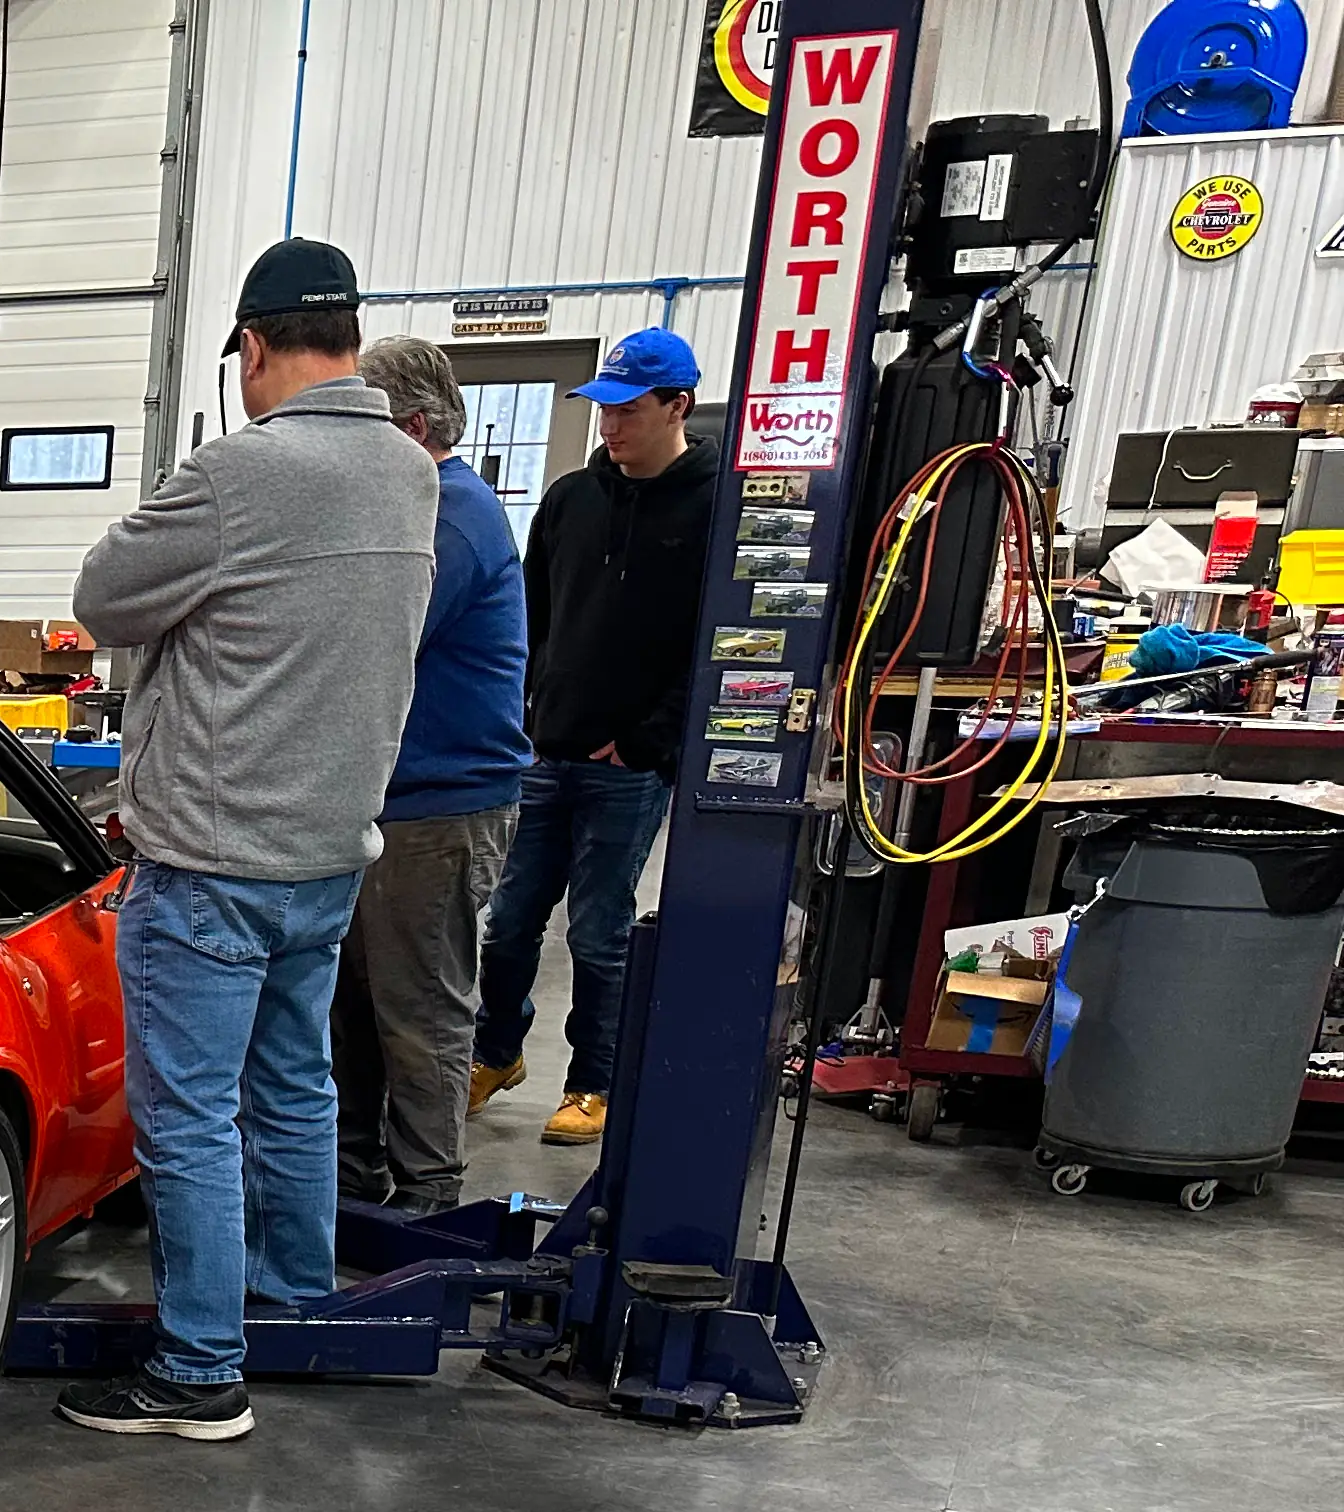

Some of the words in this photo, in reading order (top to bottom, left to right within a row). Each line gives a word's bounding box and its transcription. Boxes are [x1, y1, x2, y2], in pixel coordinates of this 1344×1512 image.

[1192, 182, 1218, 200] WE
[1223, 180, 1252, 200] USE
[770, 46, 882, 384] WORTH
[1182, 214, 1251, 226] CHEVROLET
[1186, 236, 1237, 256] PARTS
[301, 294, 325, 302] PENN
[325, 292, 348, 301] STATE
[456, 302, 468, 312] IT
[470, 302, 480, 311] IS
[484, 301, 516, 311] WHAT
[518, 300, 531, 310] IT
[532, 299, 543, 309] IS
[486, 323, 504, 332] FIX
[507, 322, 544, 331] STUPID
[750, 403, 833, 433] Worth
